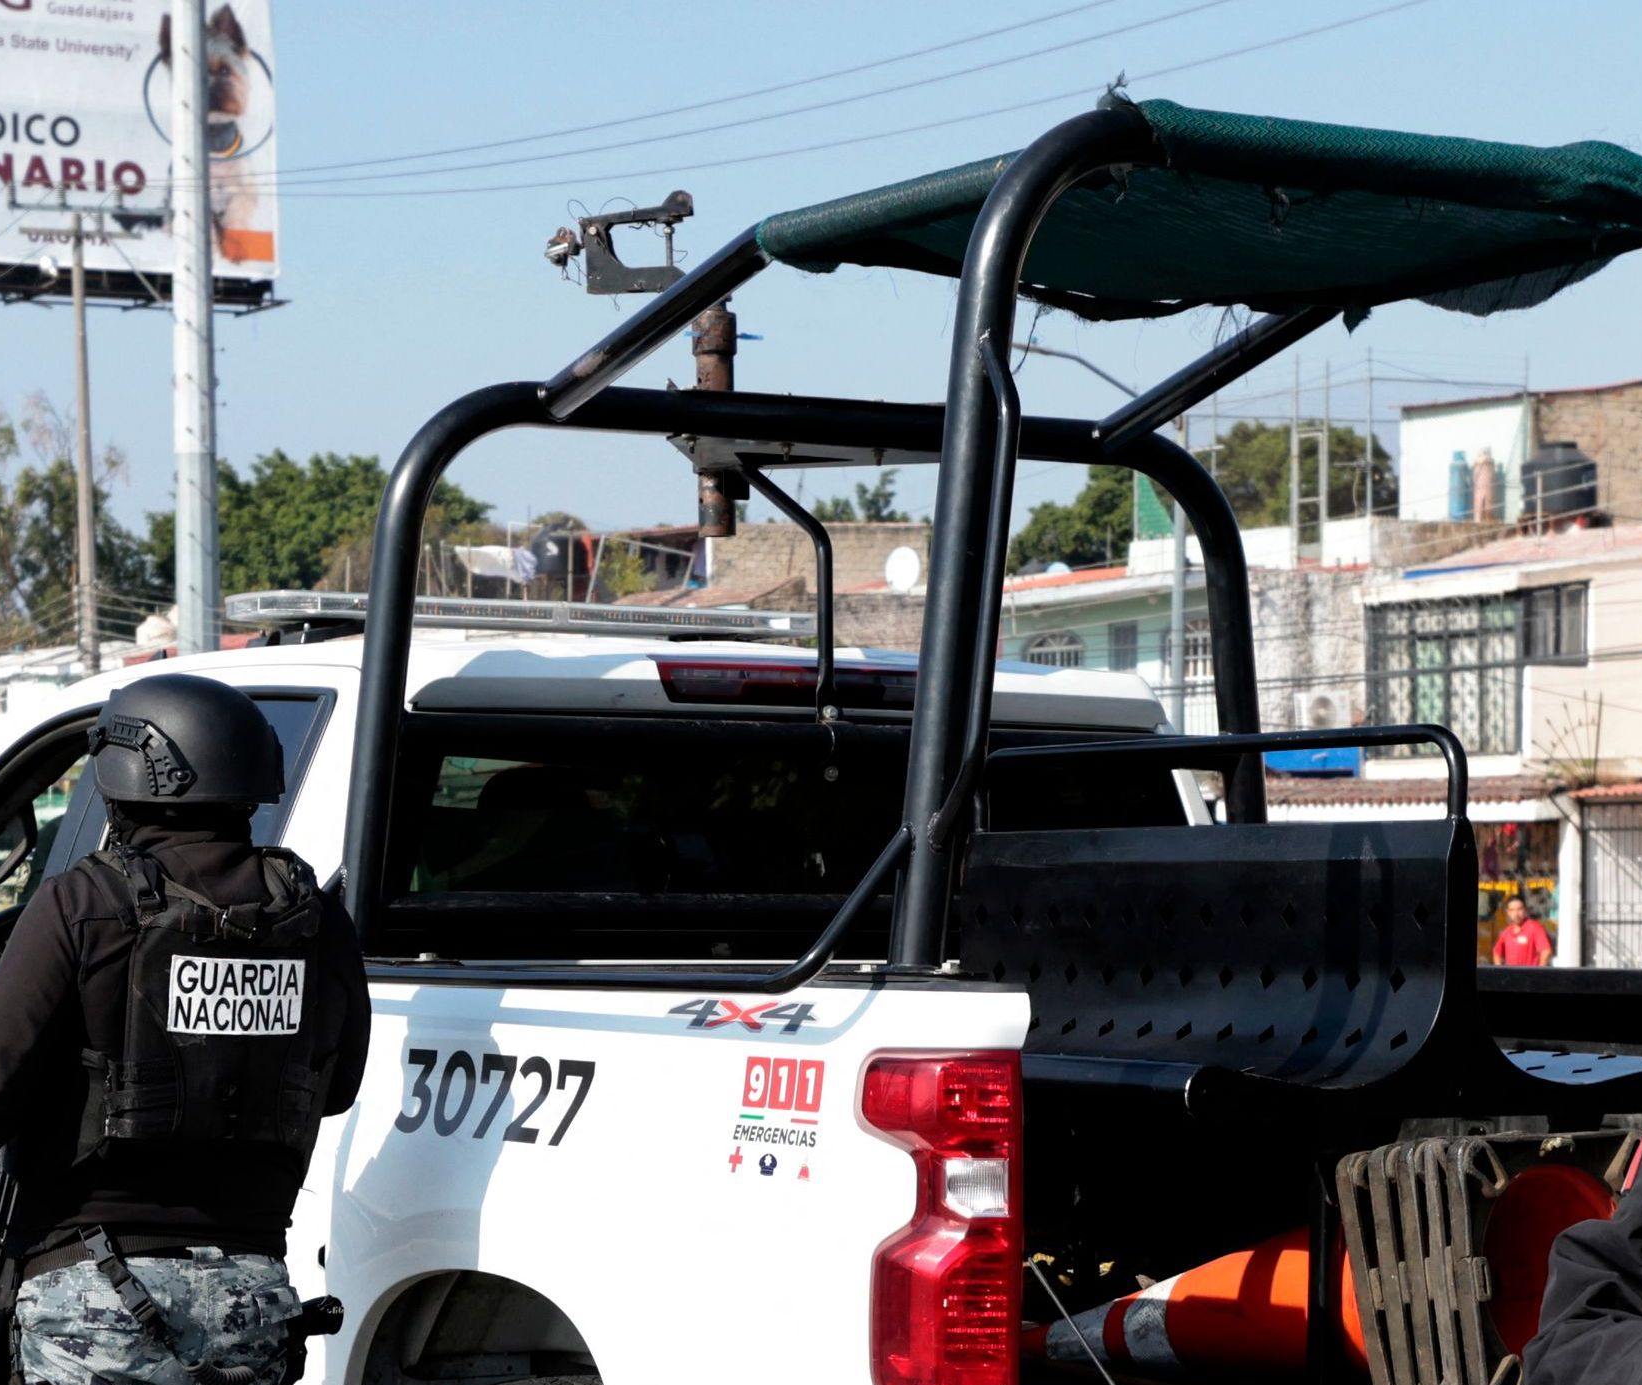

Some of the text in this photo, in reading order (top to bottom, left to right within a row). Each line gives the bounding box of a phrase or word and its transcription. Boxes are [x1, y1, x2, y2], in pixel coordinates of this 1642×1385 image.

[46, 1, 135, 22] Guadalajara
[10, 33, 50, 52] State
[176, 959, 299, 996] GUARDIA
[173, 996, 298, 1032] NACIONAL
[394, 1047, 596, 1147] 30727
[747, 1064, 818, 1105] 911
[731, 1123, 817, 1148] EMERGENCIAS
